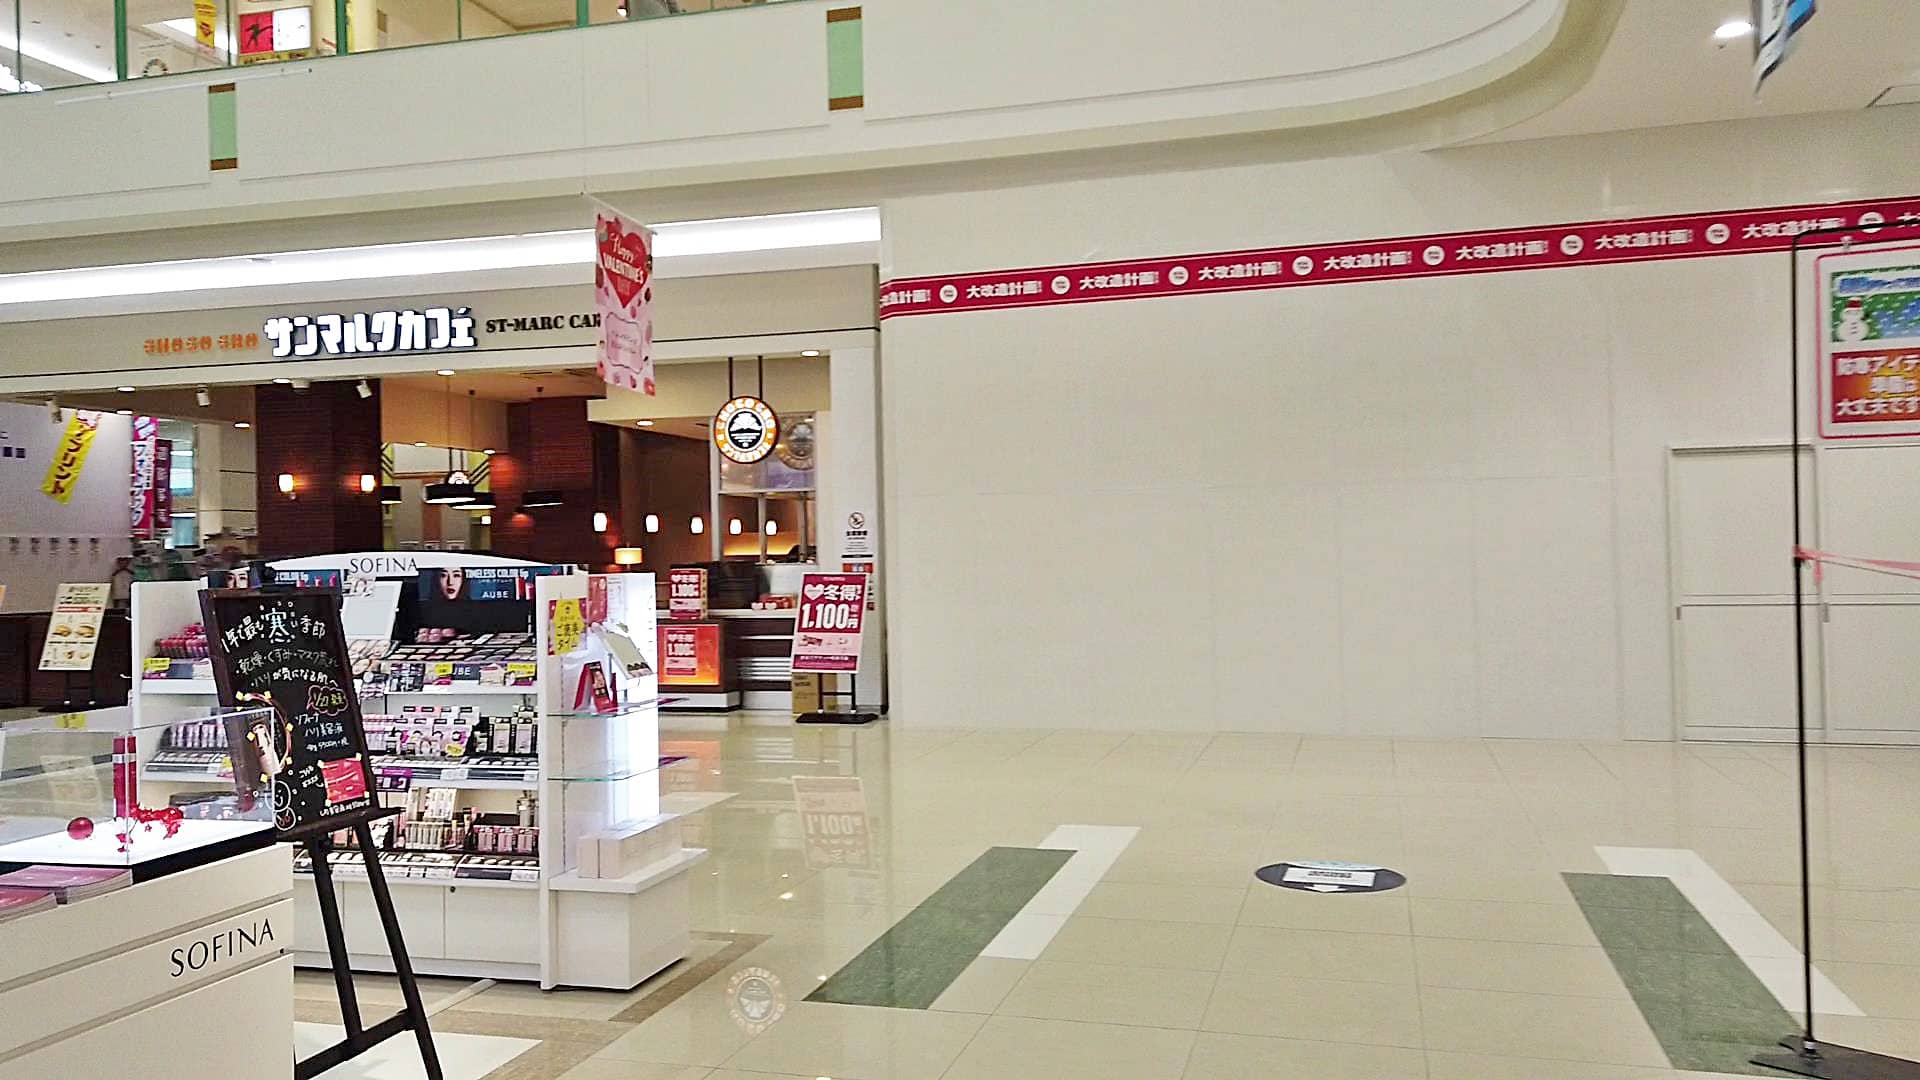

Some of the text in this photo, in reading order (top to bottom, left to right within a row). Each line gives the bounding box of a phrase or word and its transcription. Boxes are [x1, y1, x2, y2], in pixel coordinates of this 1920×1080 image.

[264, 307, 477, 357] サンマルクカフェ
[486, 315, 565, 333] ST-MARC
[350, 557, 418, 573] SOFINA
[482, 590, 509, 599] AUBE
[453, 667, 471, 675] UBE
[171, 918, 274, 977] SOFINA
